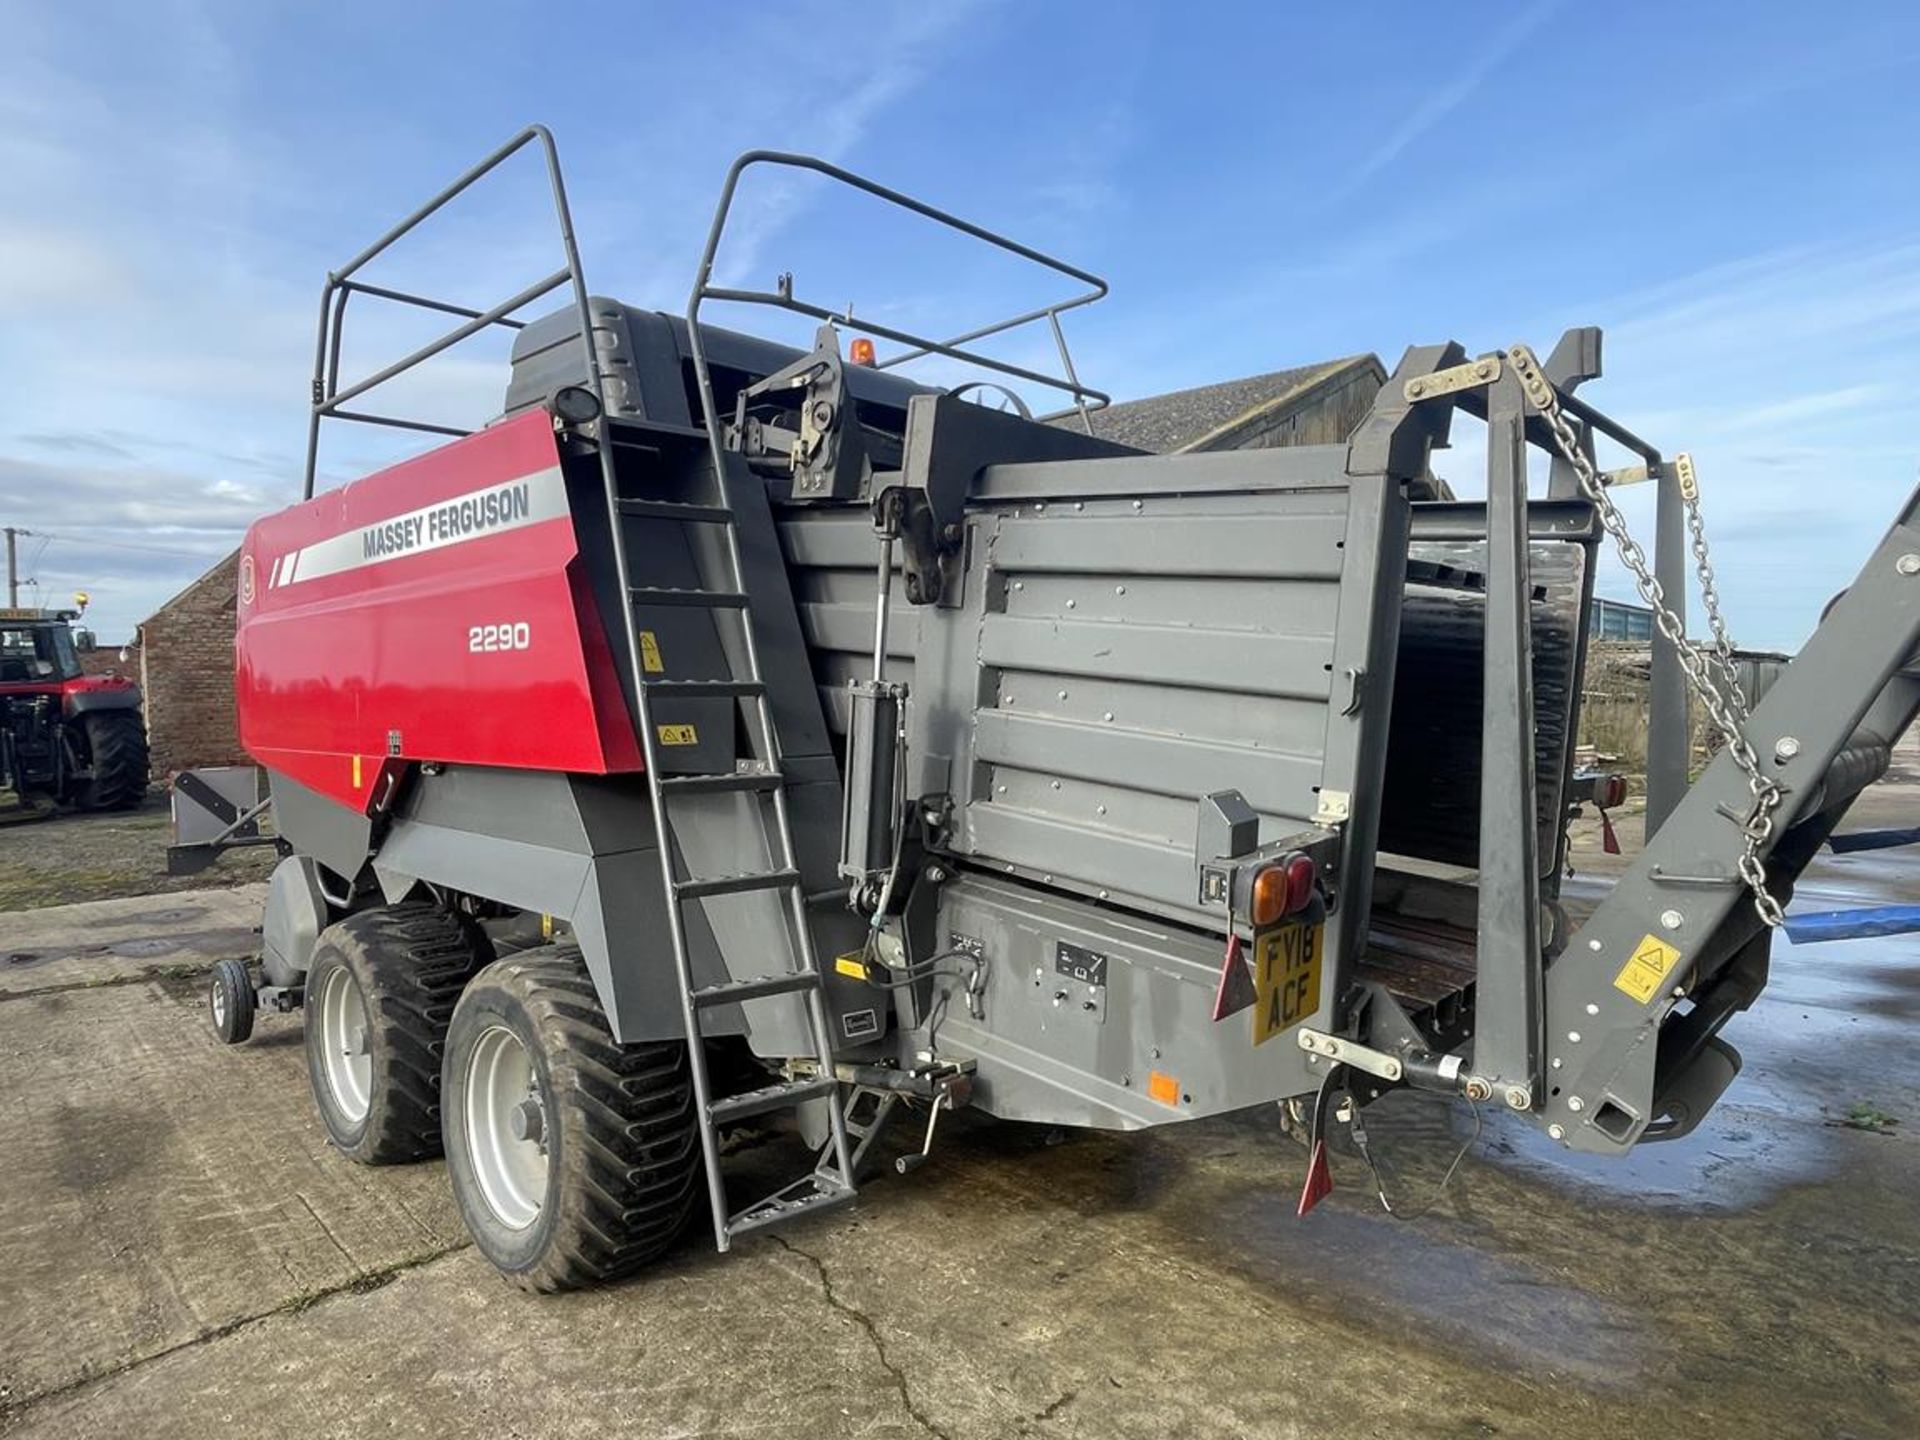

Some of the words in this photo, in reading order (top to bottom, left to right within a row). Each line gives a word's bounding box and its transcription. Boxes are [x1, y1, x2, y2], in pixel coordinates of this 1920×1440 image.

[363, 515, 424, 560] MASSEY
[428, 484, 529, 542] FERGUSON
[468, 622, 530, 652] 2290
[1267, 925, 1314, 982] FY18
[1269, 972, 1310, 1031] ACF
